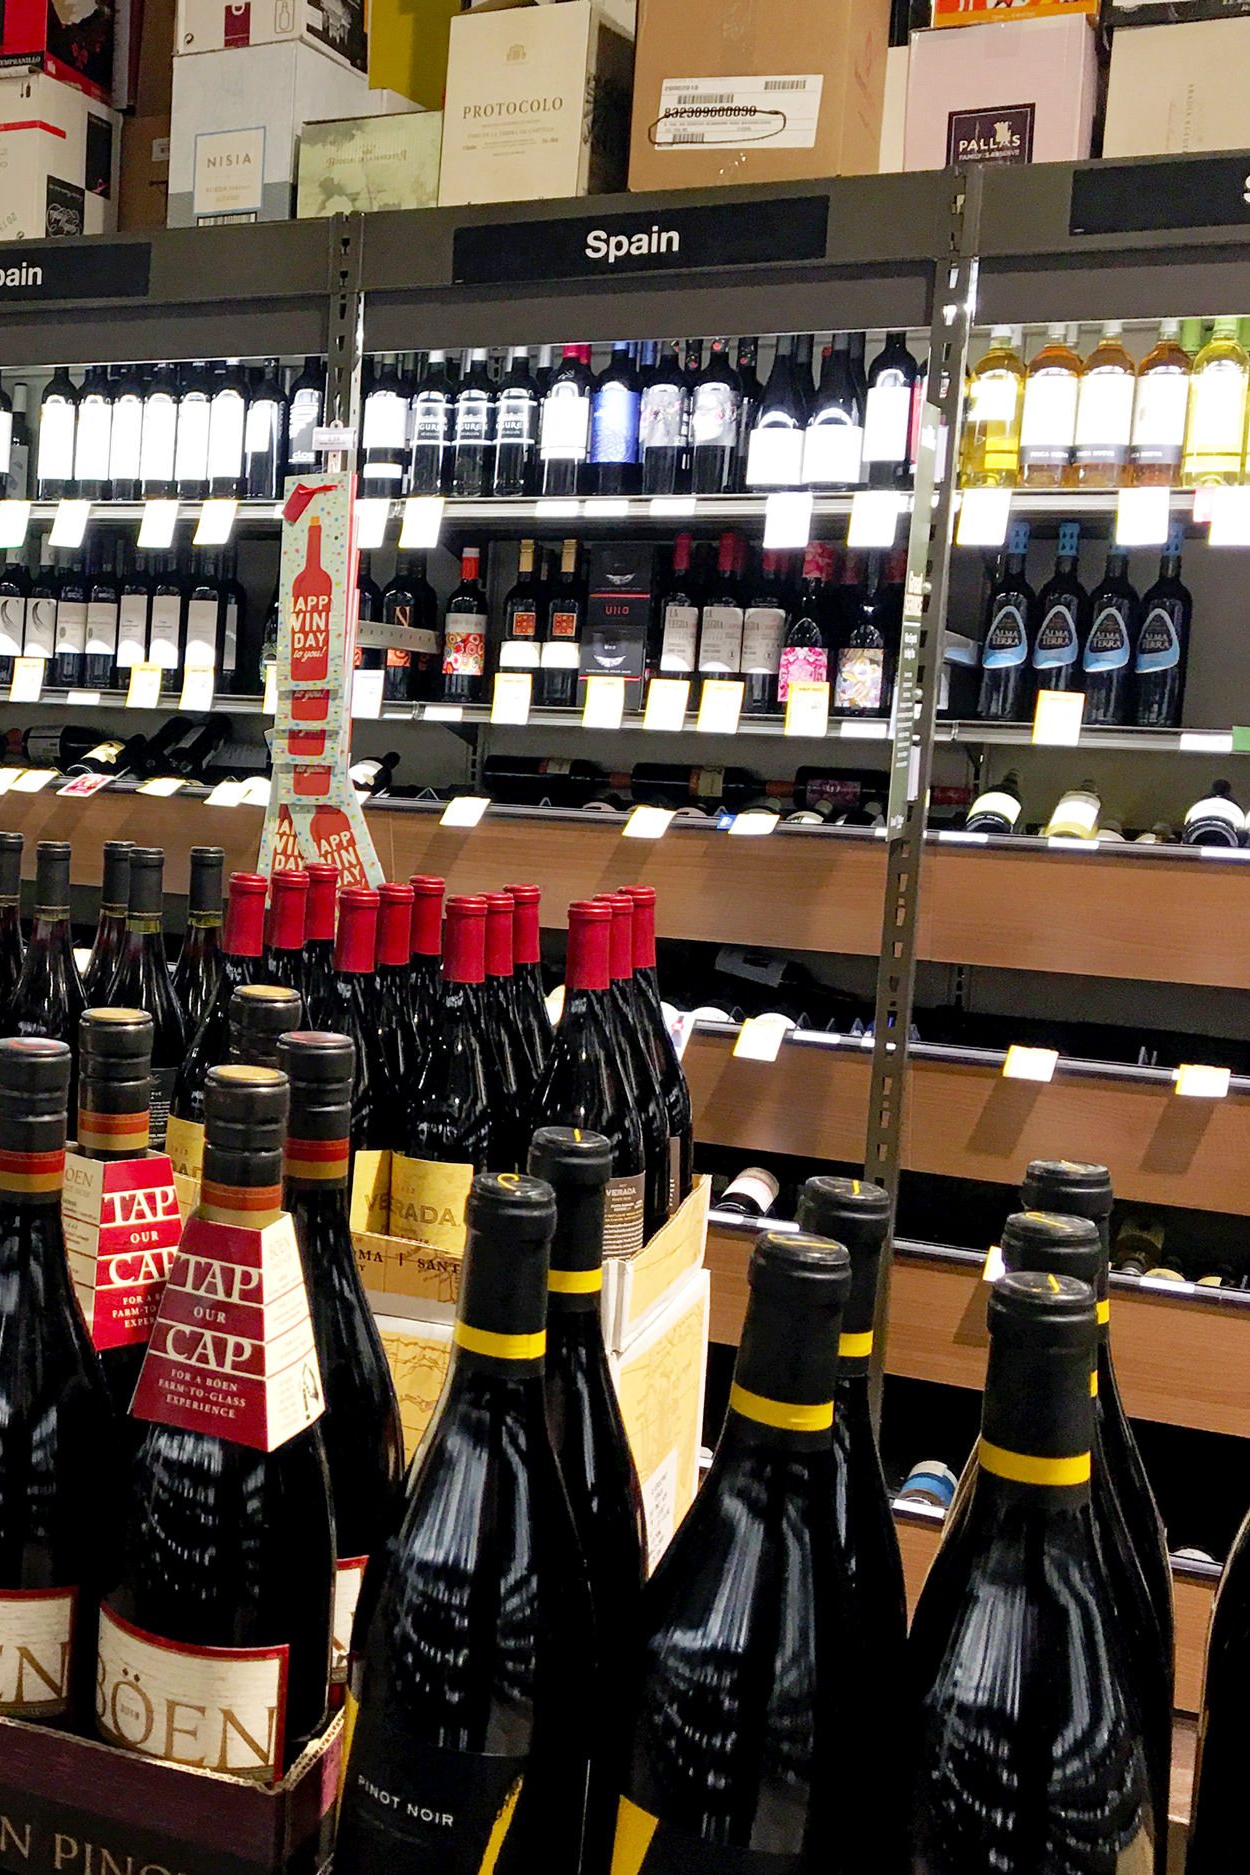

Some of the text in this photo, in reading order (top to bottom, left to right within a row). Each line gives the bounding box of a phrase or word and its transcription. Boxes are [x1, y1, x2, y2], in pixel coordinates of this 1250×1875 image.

[462, 96, 564, 119] PROTOCOLO
[207, 153, 252, 168] NISIA
[585, 226, 680, 263] Spain
[286, 611, 339, 632] WINE
[294, 632, 325, 648] DAY
[991, 636, 1020, 646] TERRA
[1041, 635, 1070, 646] TERRA
[1093, 638, 1122, 648] TERRA
[1142, 639, 1170, 649] TERRA
[294, 646, 326, 663] to you!
[103, 1186, 176, 1226] TAP
[130, 1231, 159, 1243] OUR
[109, 1250, 178, 1285] CAP
[179, 1254, 261, 1304] TAP
[193, 1306, 226, 1324] OUR
[166, 1326, 252, 1371] CAP
[170, 1368, 192, 1381] FOR
[194, 1374, 202, 1385] A
[158, 1379, 247, 1408] FARM-TO-GLASS
[165, 1394, 236, 1418] EXPERIENCE
[356, 1773, 454, 1827] PINOT NOIR
